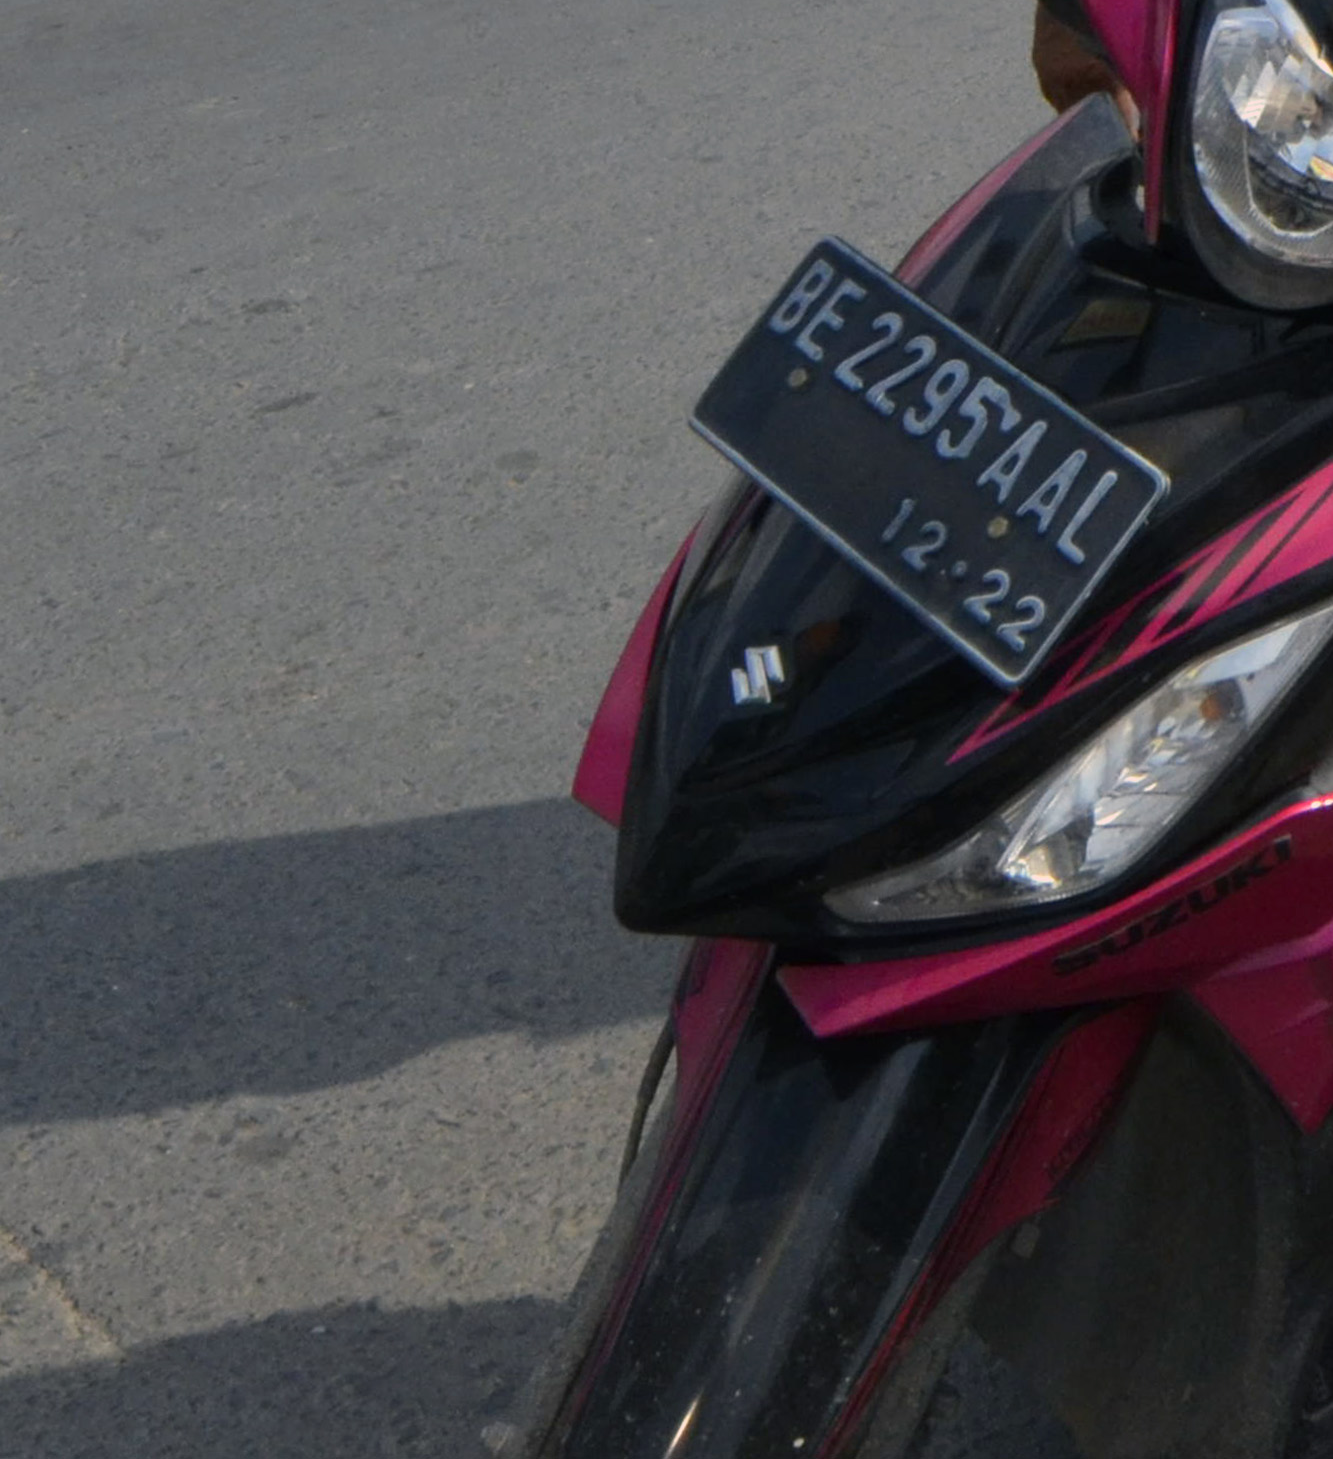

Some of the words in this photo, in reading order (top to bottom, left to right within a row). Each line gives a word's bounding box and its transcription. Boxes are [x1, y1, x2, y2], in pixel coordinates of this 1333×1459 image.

[769, 258, 868, 361] BE
[834, 312, 1022, 459] 2295
[976, 420, 1118, 565] AAL
[1051, 833, 1293, 977] SUZUKI
